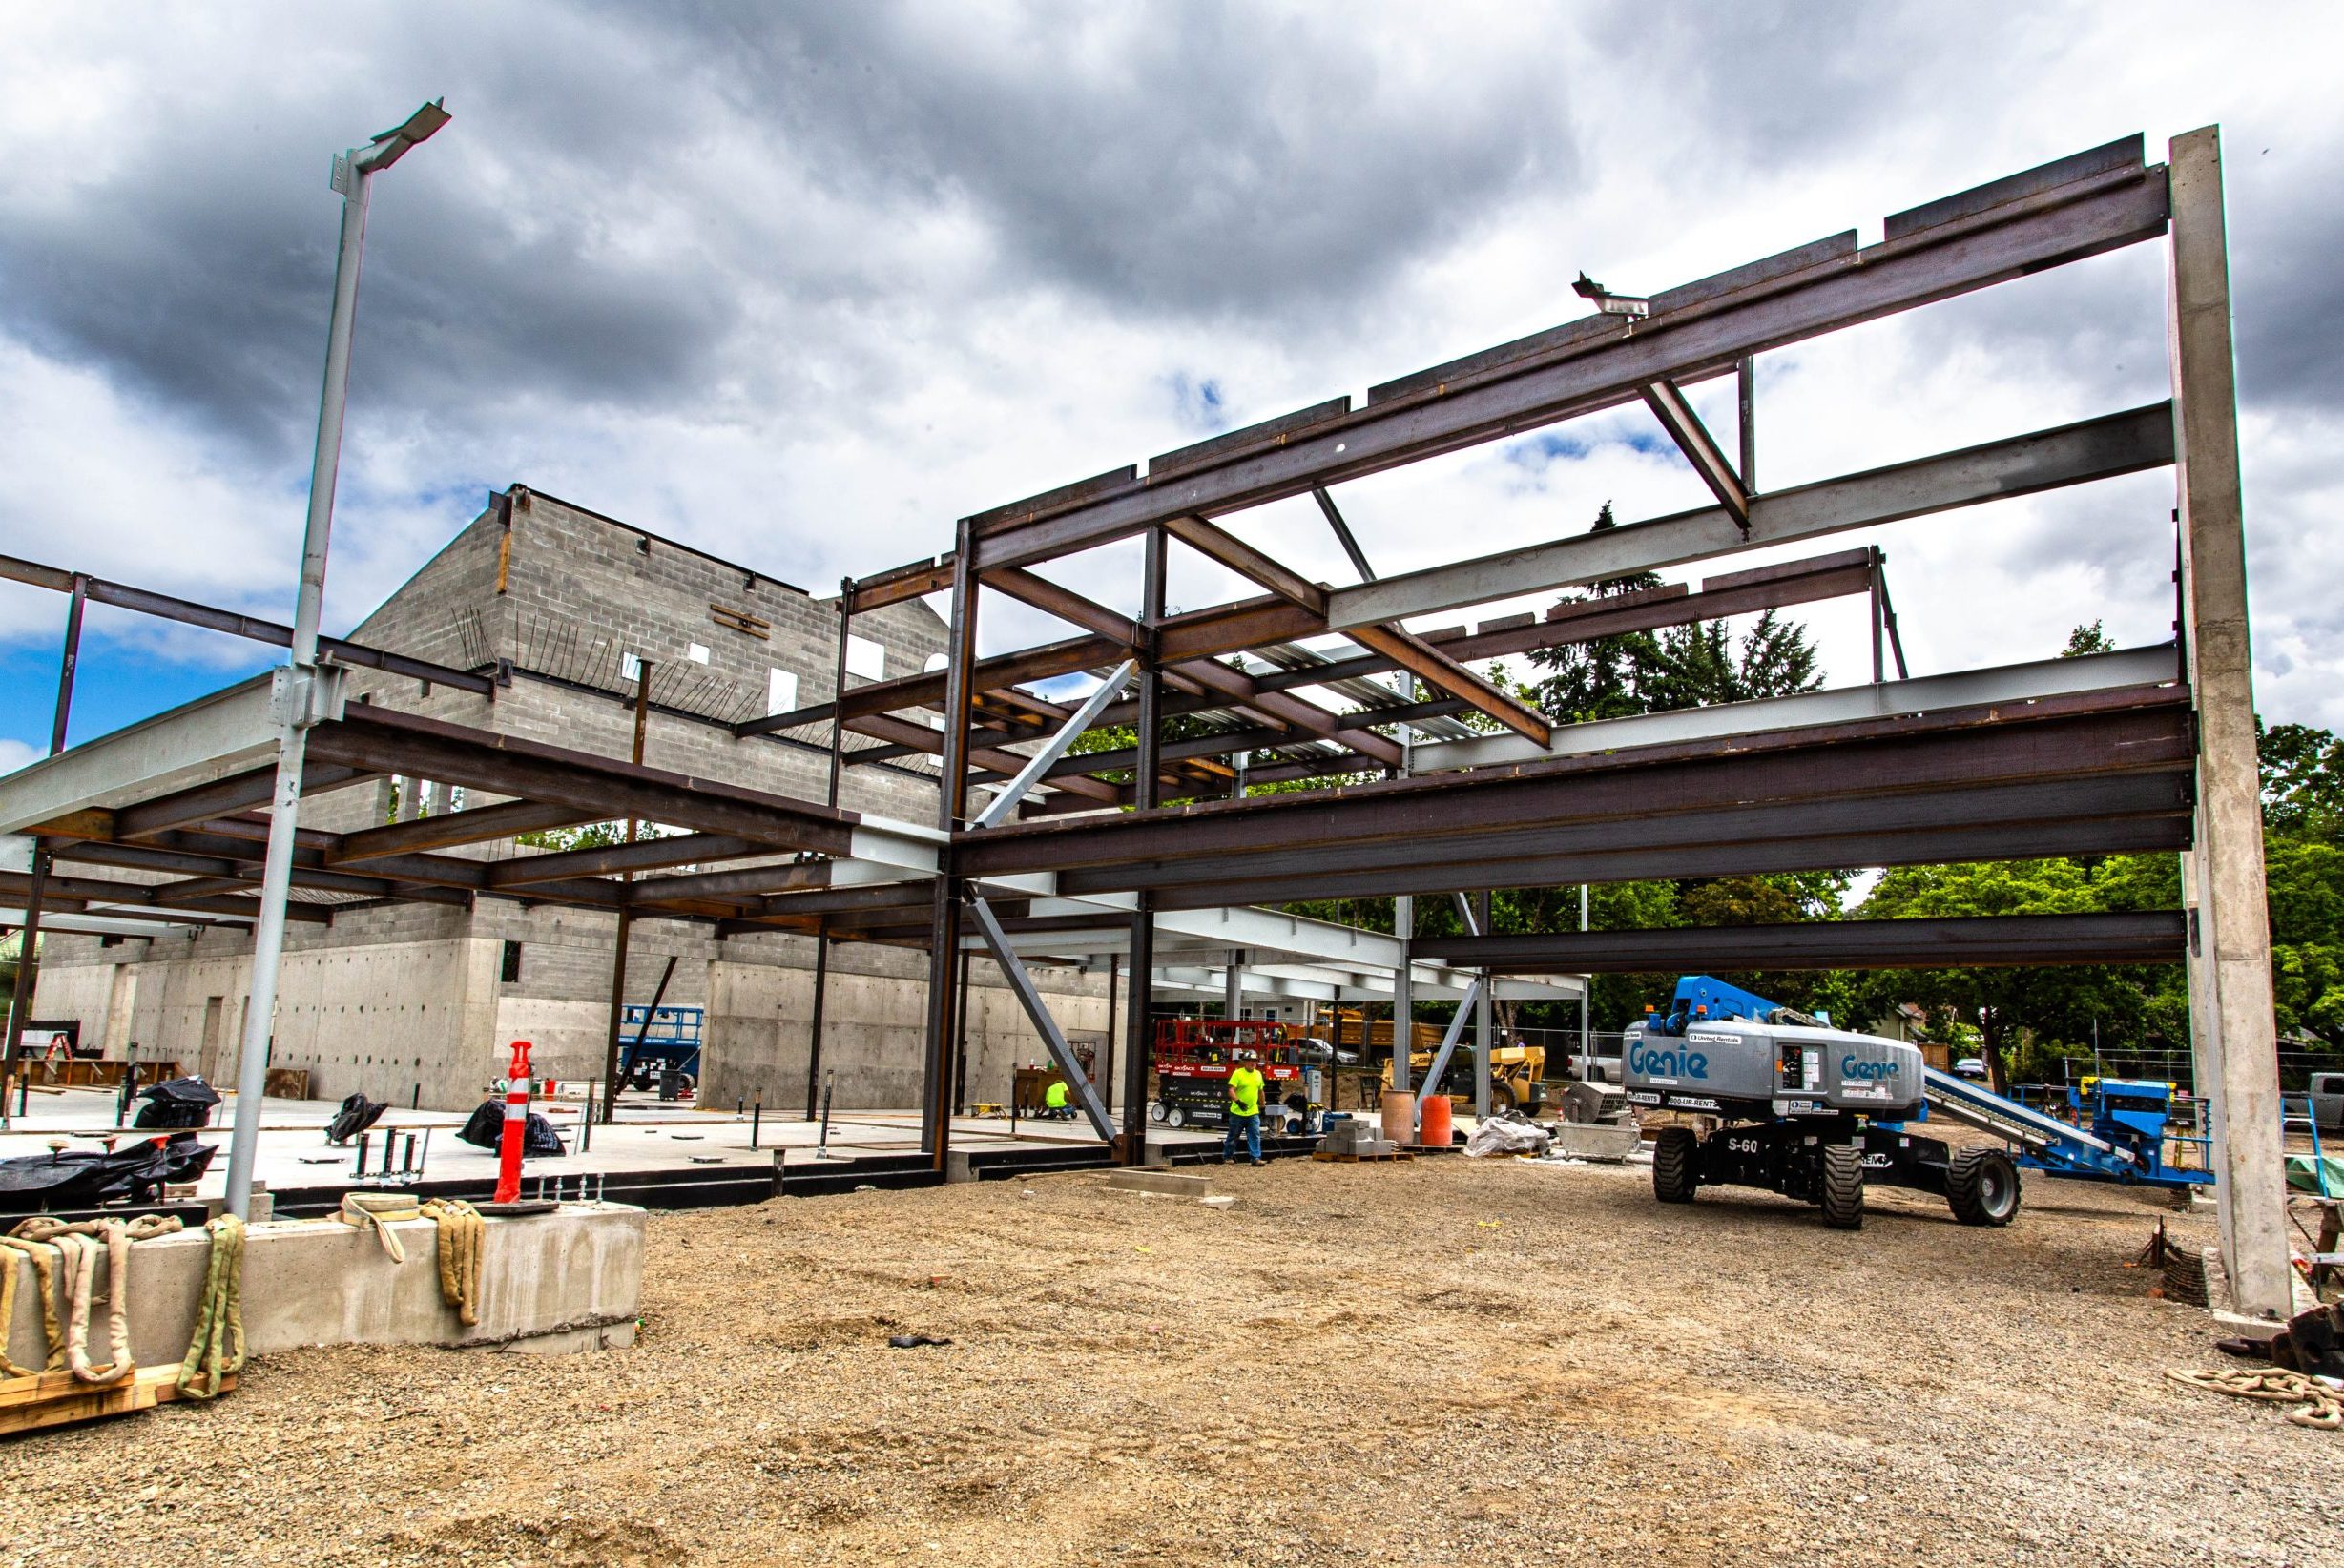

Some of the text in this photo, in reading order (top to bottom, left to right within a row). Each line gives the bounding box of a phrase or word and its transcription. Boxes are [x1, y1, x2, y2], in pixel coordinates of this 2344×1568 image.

[1630, 1041, 1709, 1079] Genie
[1841, 1055, 1899, 1080] Genie
[1728, 1138, 1758, 1153] S-60
